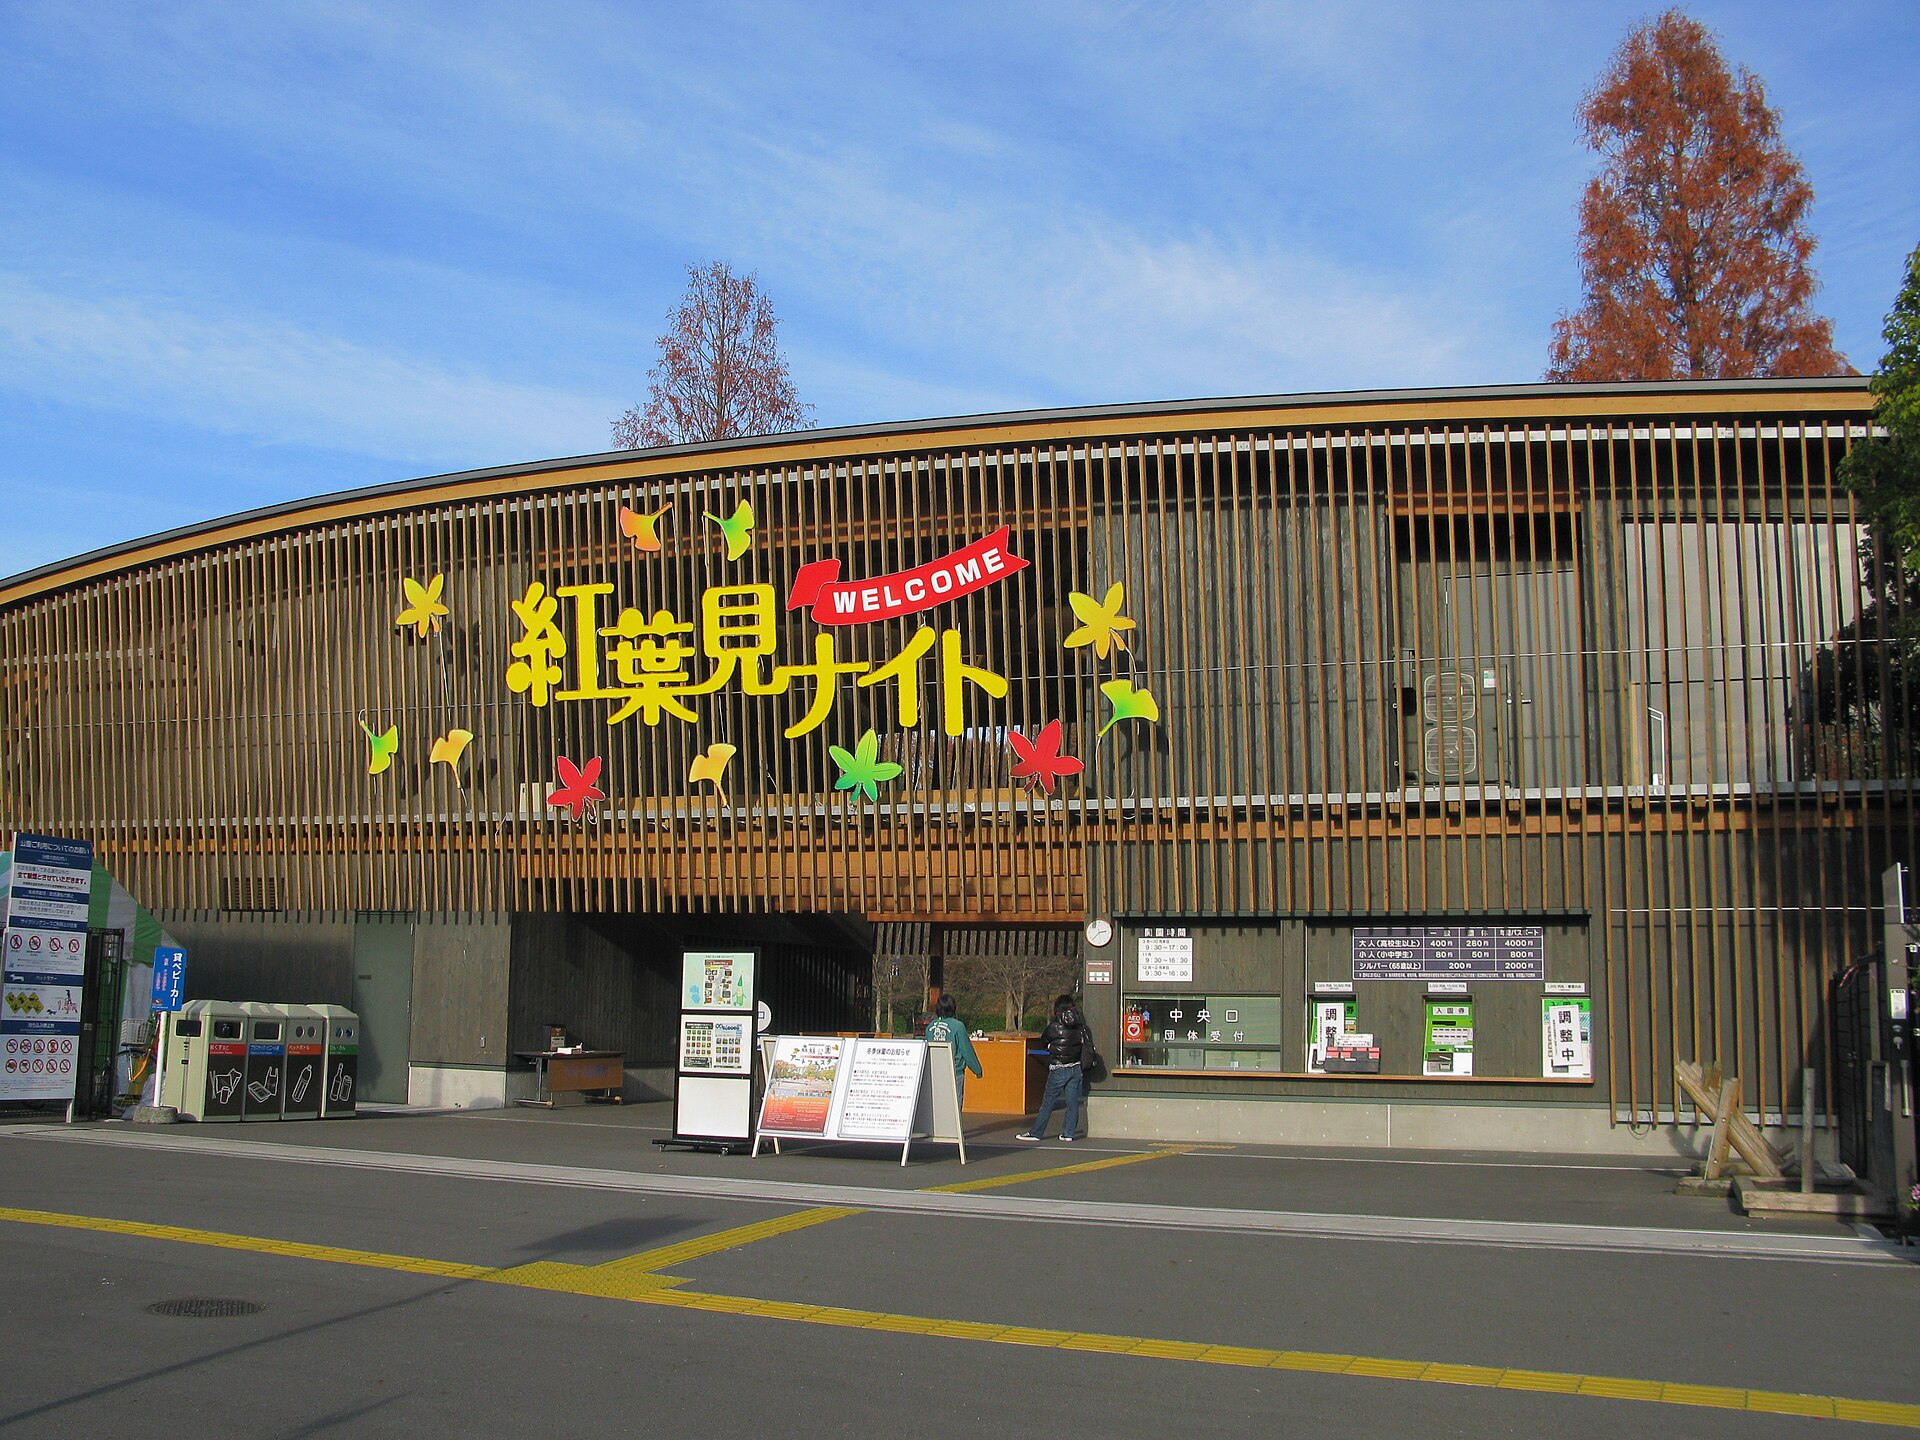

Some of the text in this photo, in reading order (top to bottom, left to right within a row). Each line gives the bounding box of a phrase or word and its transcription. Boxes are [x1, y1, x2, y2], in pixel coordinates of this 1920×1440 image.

[832, 546, 1005, 615] WELCOME
[506, 580, 1009, 739] 紅葉見ナイト
[170, 952, 183, 1007] 貸ベビーカー
[1448, 962, 1472, 970] 200円
[1505, 962, 1533, 970] 2000円
[1169, 1008, 1239, 1023] 中央口
[1164, 1030, 1244, 1042] 団体受付
[1558, 1010, 1575, 1062] 調整中
